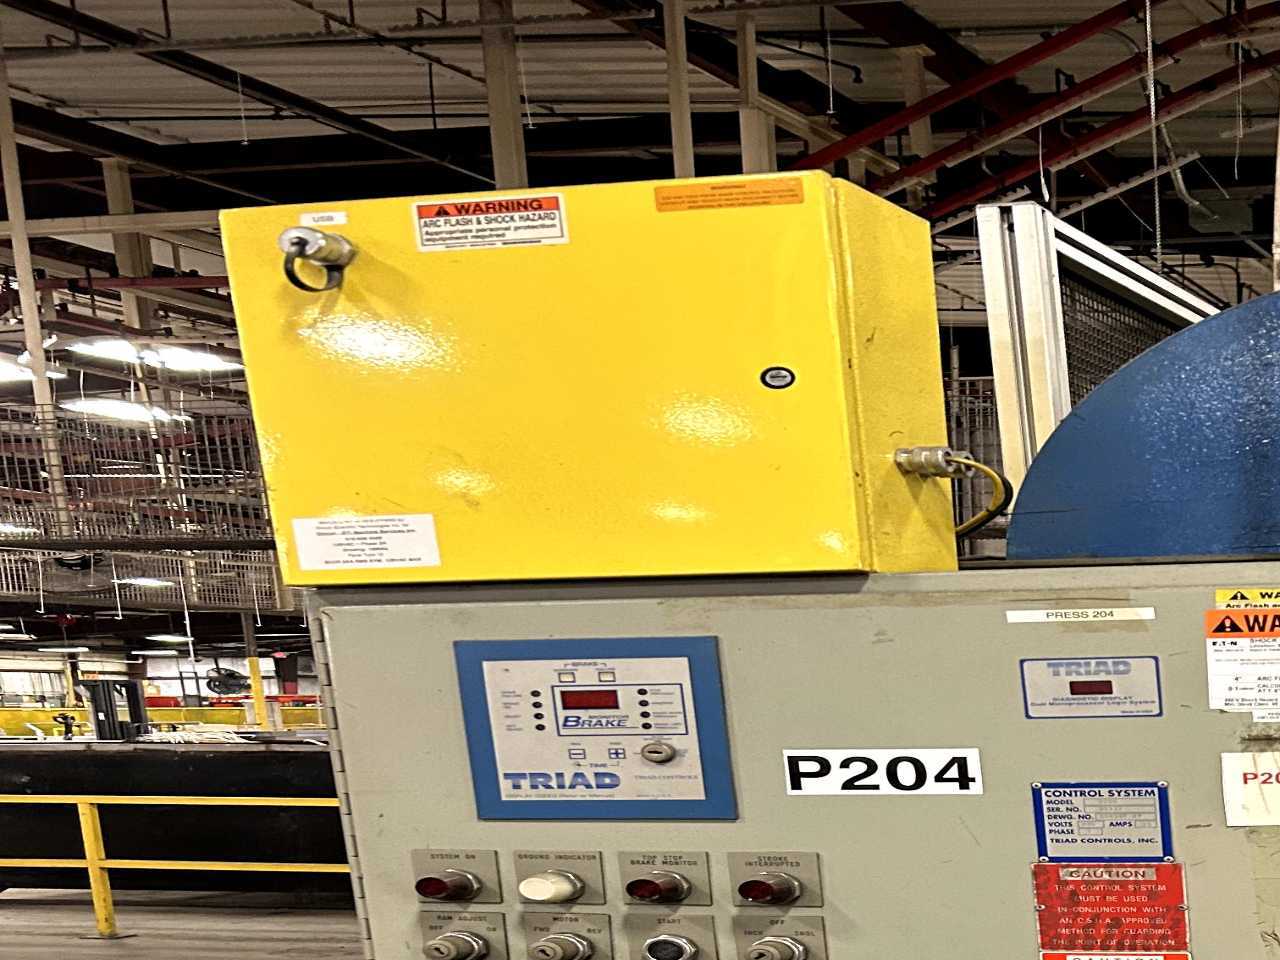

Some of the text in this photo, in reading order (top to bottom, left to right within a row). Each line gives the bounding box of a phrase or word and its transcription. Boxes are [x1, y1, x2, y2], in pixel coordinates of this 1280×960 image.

[454, 199, 543, 215] WARNING
[423, 219, 441, 228] ARC
[444, 217, 473, 227] FLASH
[484, 214, 517, 225] SHOCK
[519, 211, 557, 222] HAZARD
[1046, 610, 1114, 619] PRESS 204
[1046, 660, 1132, 677] TRIAD
[562, 715, 627, 728] BRAKE
[503, 772, 621, 790] TRIAD
[786, 755, 976, 791] P204
[1044, 789, 1156, 798] CONTROL SYSTEM
[1069, 869, 1146, 879] CAUTION
